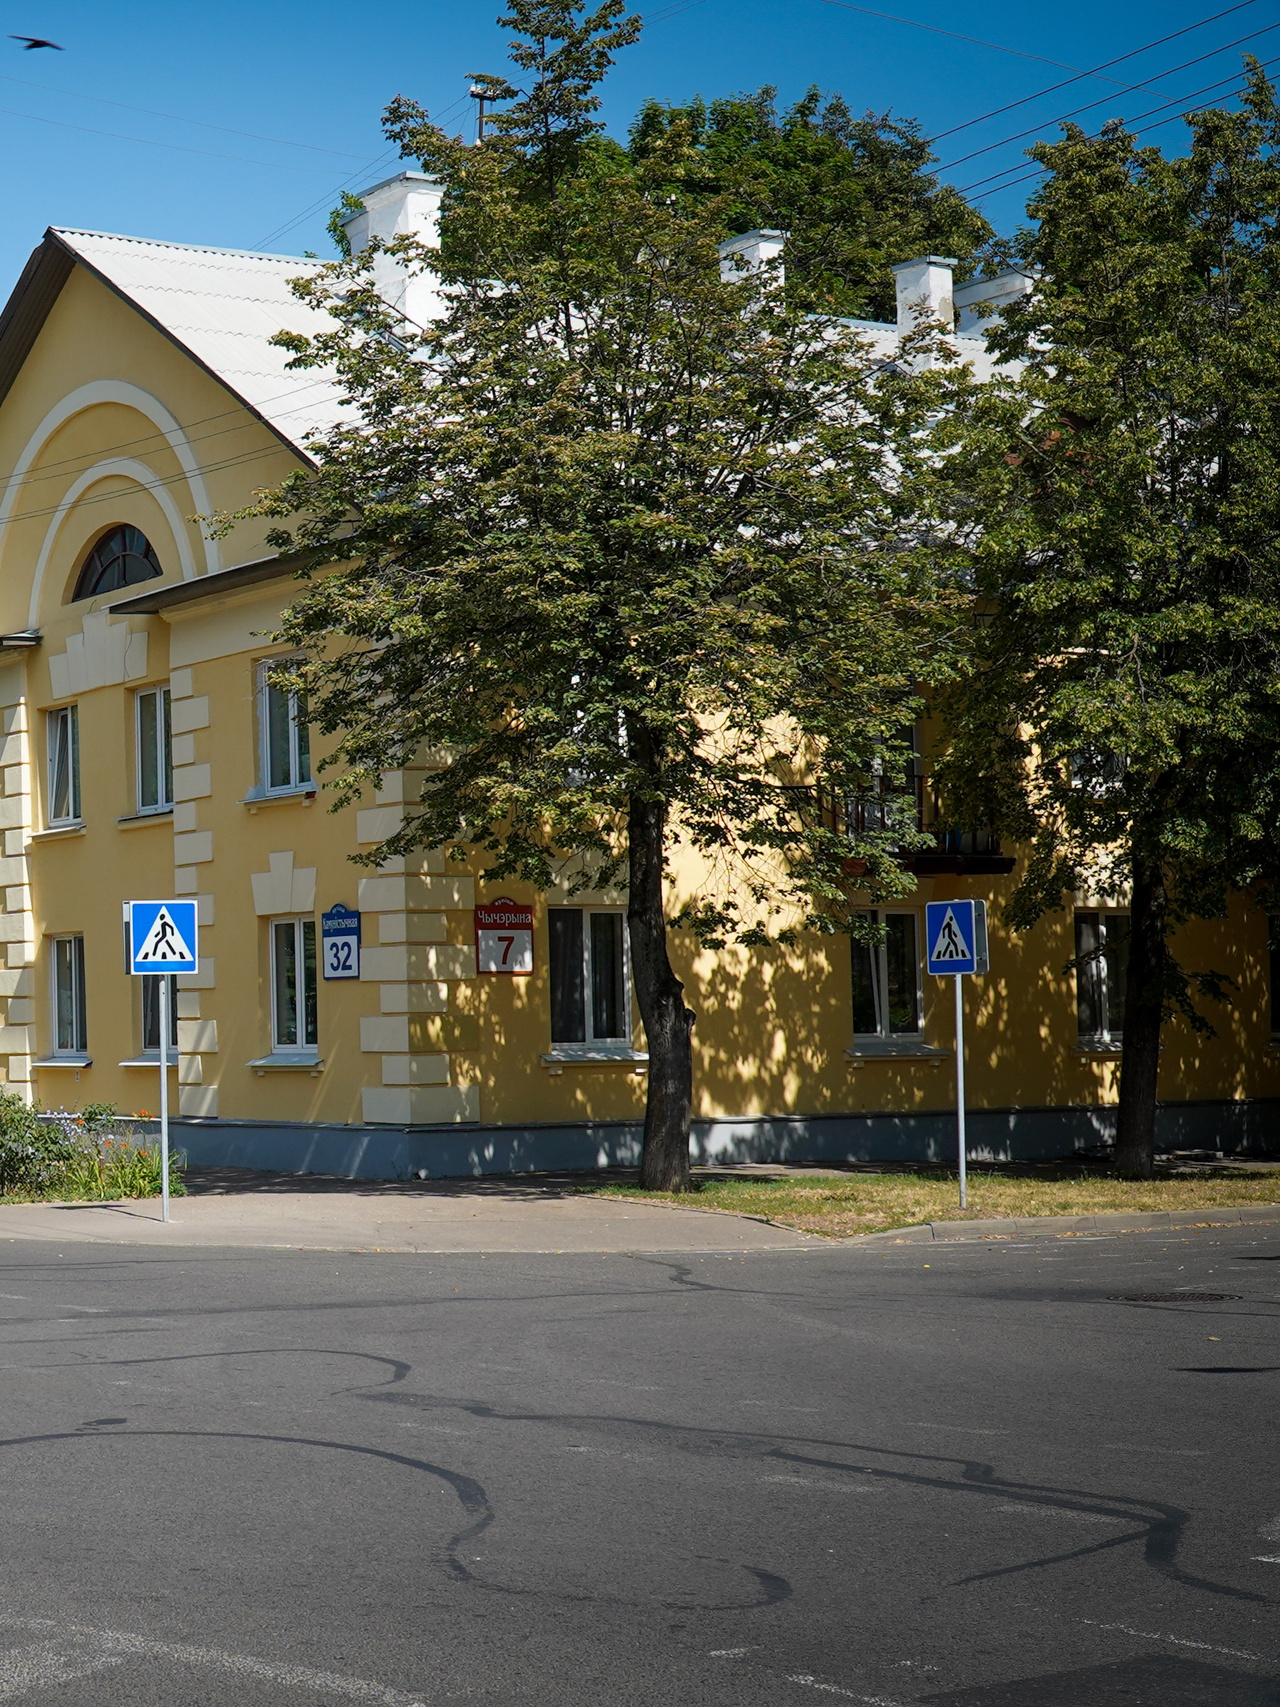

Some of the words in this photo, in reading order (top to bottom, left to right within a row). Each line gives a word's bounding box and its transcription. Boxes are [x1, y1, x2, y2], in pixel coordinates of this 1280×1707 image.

[477, 911, 532, 927] Чычэрына
[329, 941, 353, 972] 32
[497, 936, 515, 965] 7
